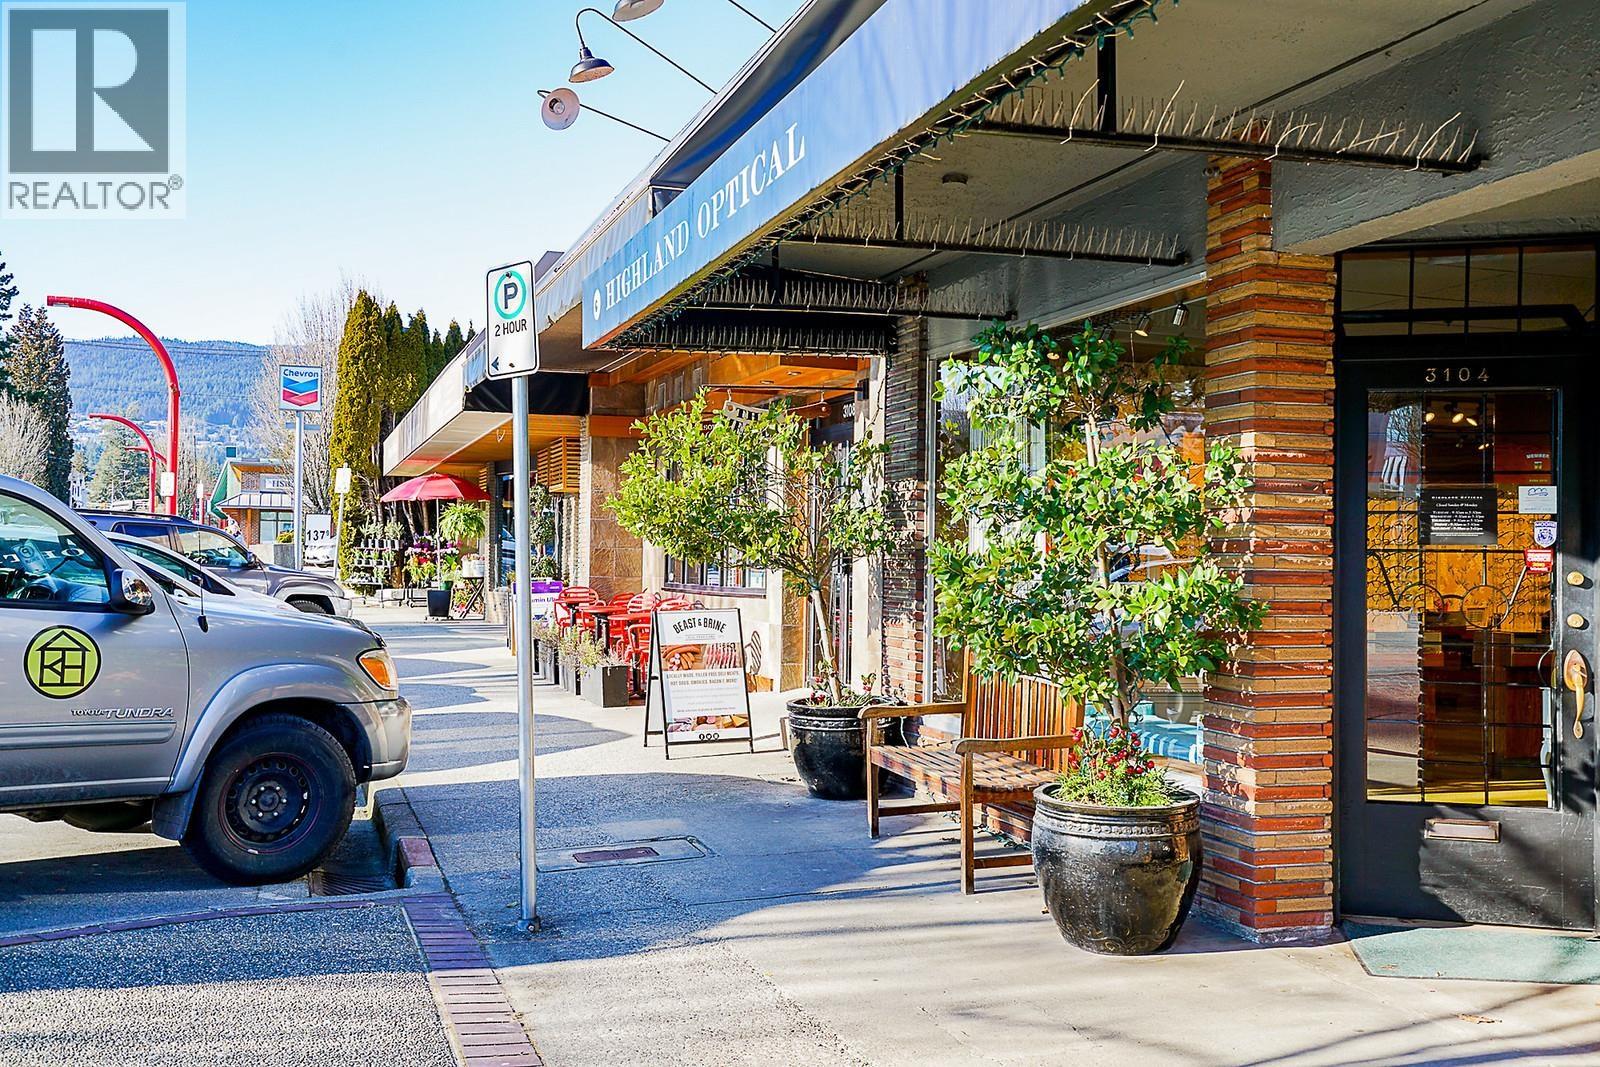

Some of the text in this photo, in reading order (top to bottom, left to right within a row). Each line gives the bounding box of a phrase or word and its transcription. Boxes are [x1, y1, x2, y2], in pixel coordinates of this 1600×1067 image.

[605, 122, 806, 311] HIGHLAND OPTICAL
[503, 282, 518, 310] P
[494, 319, 528, 337] 2 HOUR
[283, 368, 319, 378] Chevron
[1424, 367, 1490, 383] 3104
[672, 617, 727, 634] BEAST & BRINE
[71, 707, 174, 719] TOYOTA TUNDRA
